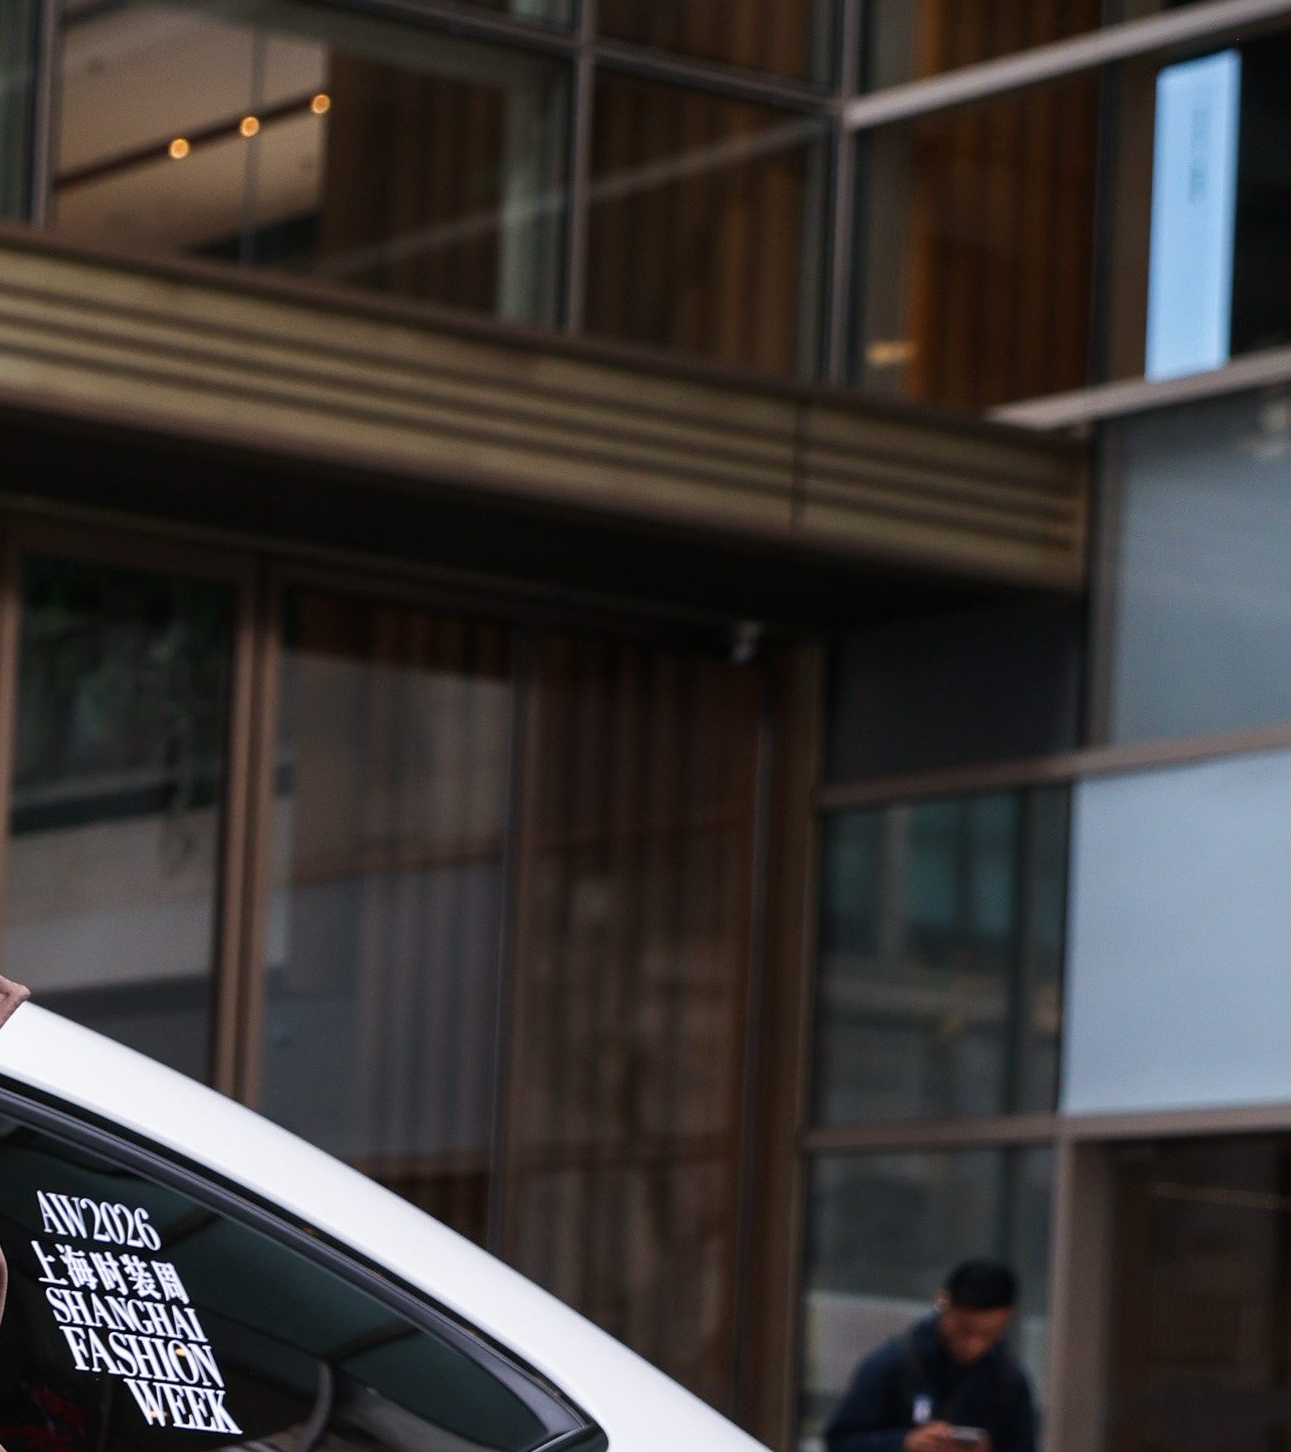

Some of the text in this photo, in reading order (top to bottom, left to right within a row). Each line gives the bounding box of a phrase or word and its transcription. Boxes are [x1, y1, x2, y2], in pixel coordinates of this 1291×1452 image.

[36, 1190, 162, 1251] AW2026
[30, 1240, 190, 1305] 上海时装周
[45, 1286, 209, 1343] SHANGHAI
[58, 1325, 226, 1388] FASHION
[122, 1377, 244, 1435] WEEK
